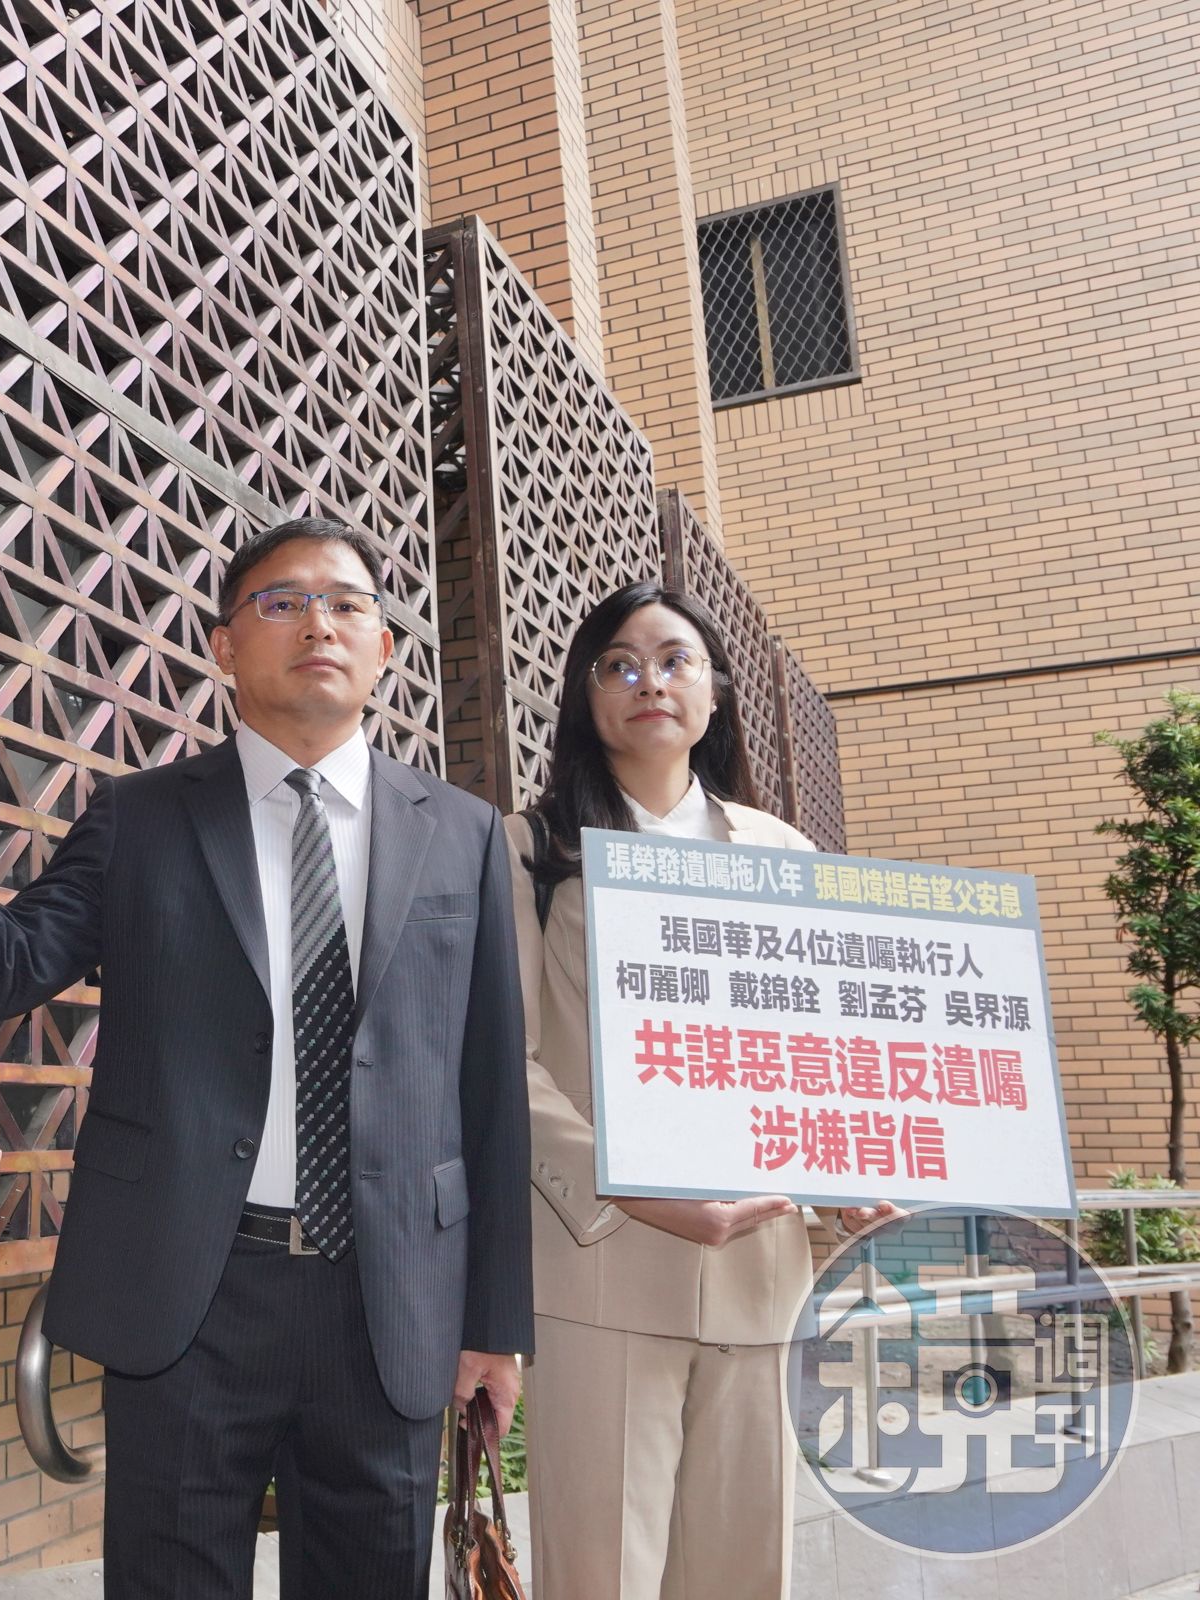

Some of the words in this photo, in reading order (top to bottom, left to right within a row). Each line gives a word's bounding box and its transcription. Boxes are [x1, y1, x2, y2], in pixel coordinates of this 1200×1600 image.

[605, 841, 804, 897] 張榮發遺囑拖八年
[813, 863, 1023, 919] 張國煒提告望父安息
[660, 915, 983, 980] 張國華及4位遺囑執行人
[616, 960, 710, 1005] 柯麗卿
[728, 970, 821, 1014] 戴錦銓
[838, 980, 927, 1023] 劉孟芬
[945, 990, 1032, 1032] 吳界源
[634, 1018, 1028, 1111] 共謀惡意違反遺囑
[749, 1104, 948, 1181] 涉嫌背信
